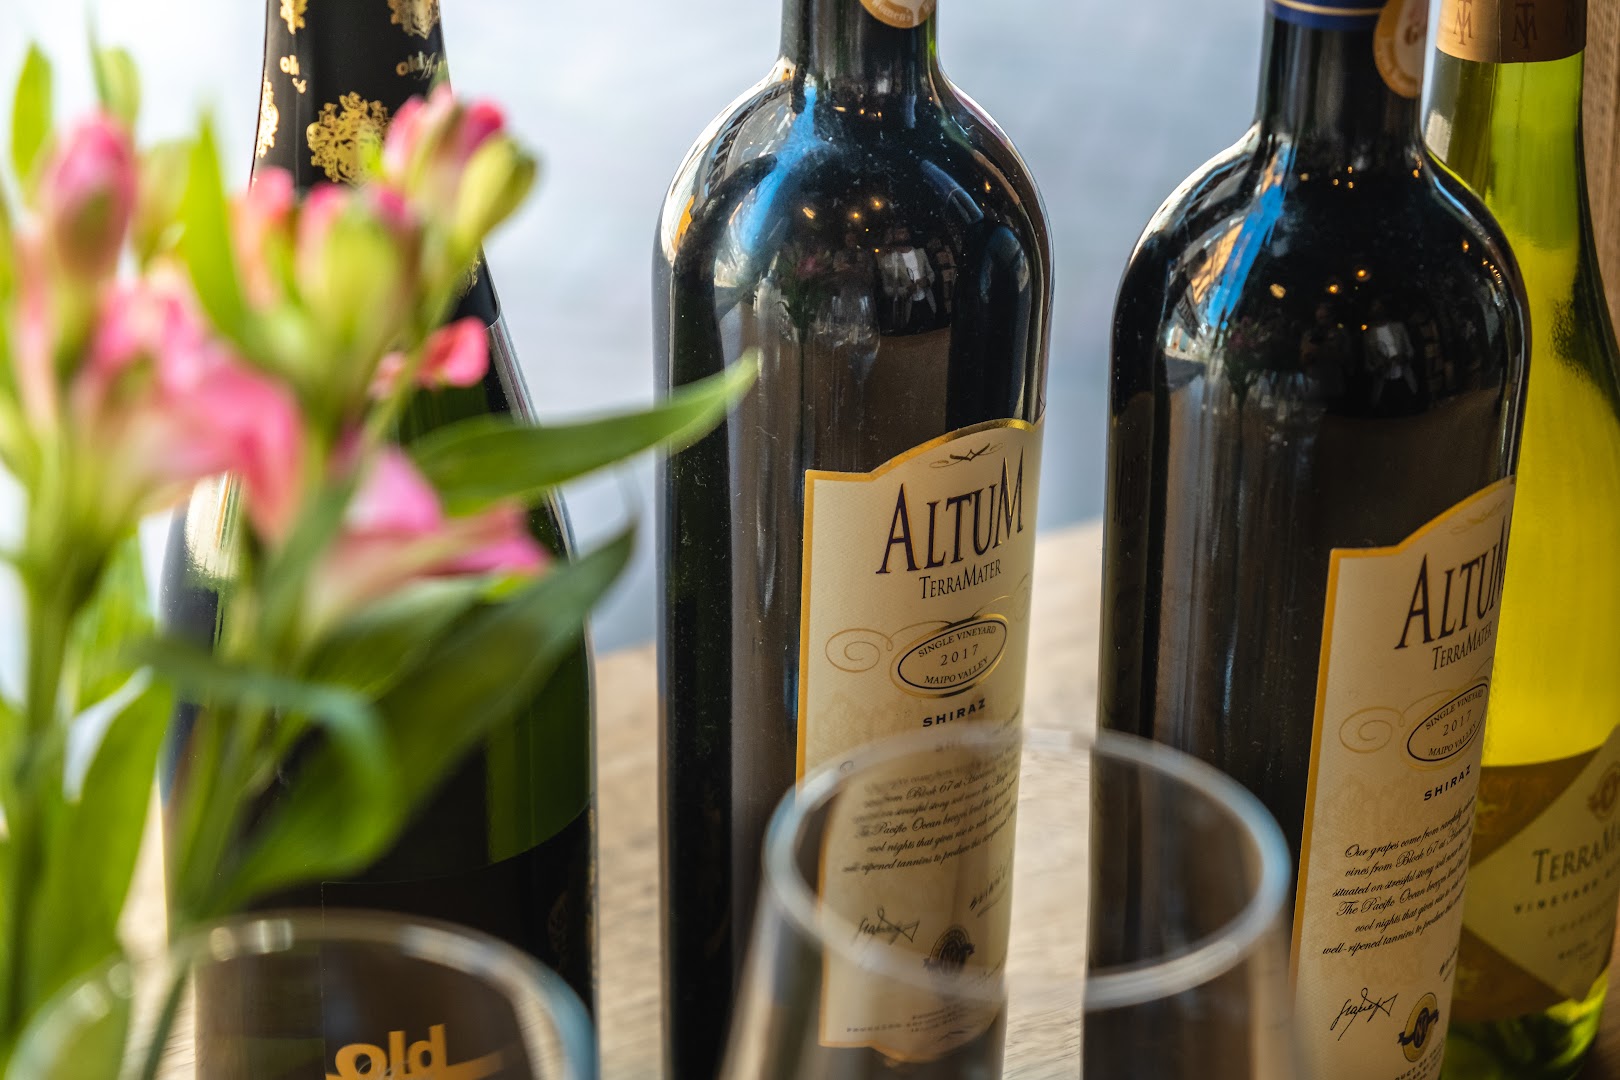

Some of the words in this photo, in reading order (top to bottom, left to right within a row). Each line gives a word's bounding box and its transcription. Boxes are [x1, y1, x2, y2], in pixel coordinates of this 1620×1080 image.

[875, 445, 1024, 575] ALTUM
[919, 558, 1002, 600] TERRAMATER
[918, 635, 955, 658] SINGLE
[956, 625, 996, 641] VINEYARD
[940, 643, 979, 667] 2017
[924, 674, 956, 684] MAIPO
[957, 656, 989, 680] VALLEY
[922, 698, 986, 728] SHIRAZ
[1425, 704, 1456, 731] SINGLE
[1442, 709, 1472, 737] 2017
[1428, 744, 1454, 757] MAIPO
[939, 780, 953, 794] 67
[1423, 763, 1472, 801] SHIRAZ
[912, 817, 941, 832] Ocean
[887, 836, 915, 856] nights
[916, 833, 934, 848] that
[1344, 843, 1369, 858] Our
[1367, 841, 1400, 861] grapes
[1400, 835, 1422, 847] come
[1417, 826, 1439, 847] from
[1345, 867, 1370, 877] vines
[1364, 861, 1393, 879] from
[1396, 849, 1425, 867] Block
[1426, 839, 1440, 856] 67
[1332, 882, 1372, 897] situated
[1371, 883, 1383, 893] on
[1337, 900, 1360, 916] The
[1360, 896, 1396, 914] Pacific
[1399, 888, 1426, 904] Ocean
[1354, 919, 1376, 933] cool
[1375, 914, 1402, 933] nights
[1401, 909, 1418, 921] that
[1383, 928, 1414, 945] tannins
[1414, 925, 1423, 935] to
